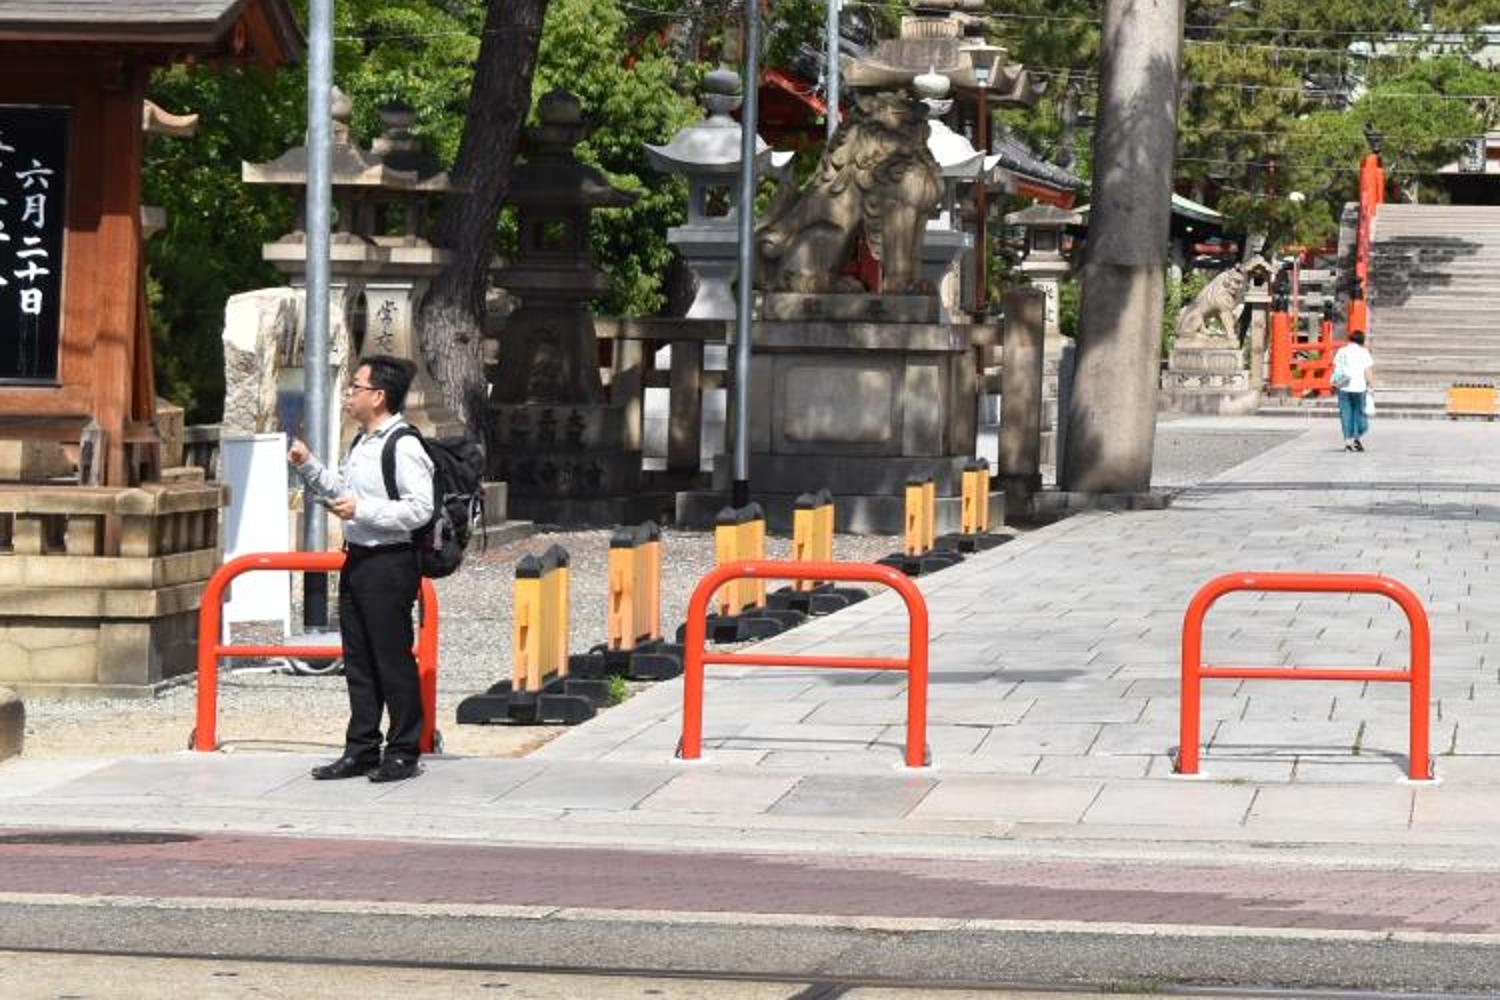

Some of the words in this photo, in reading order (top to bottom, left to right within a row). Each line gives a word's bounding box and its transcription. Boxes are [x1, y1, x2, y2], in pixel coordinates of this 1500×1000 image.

[13, 159, 55, 315] 六月二十日
